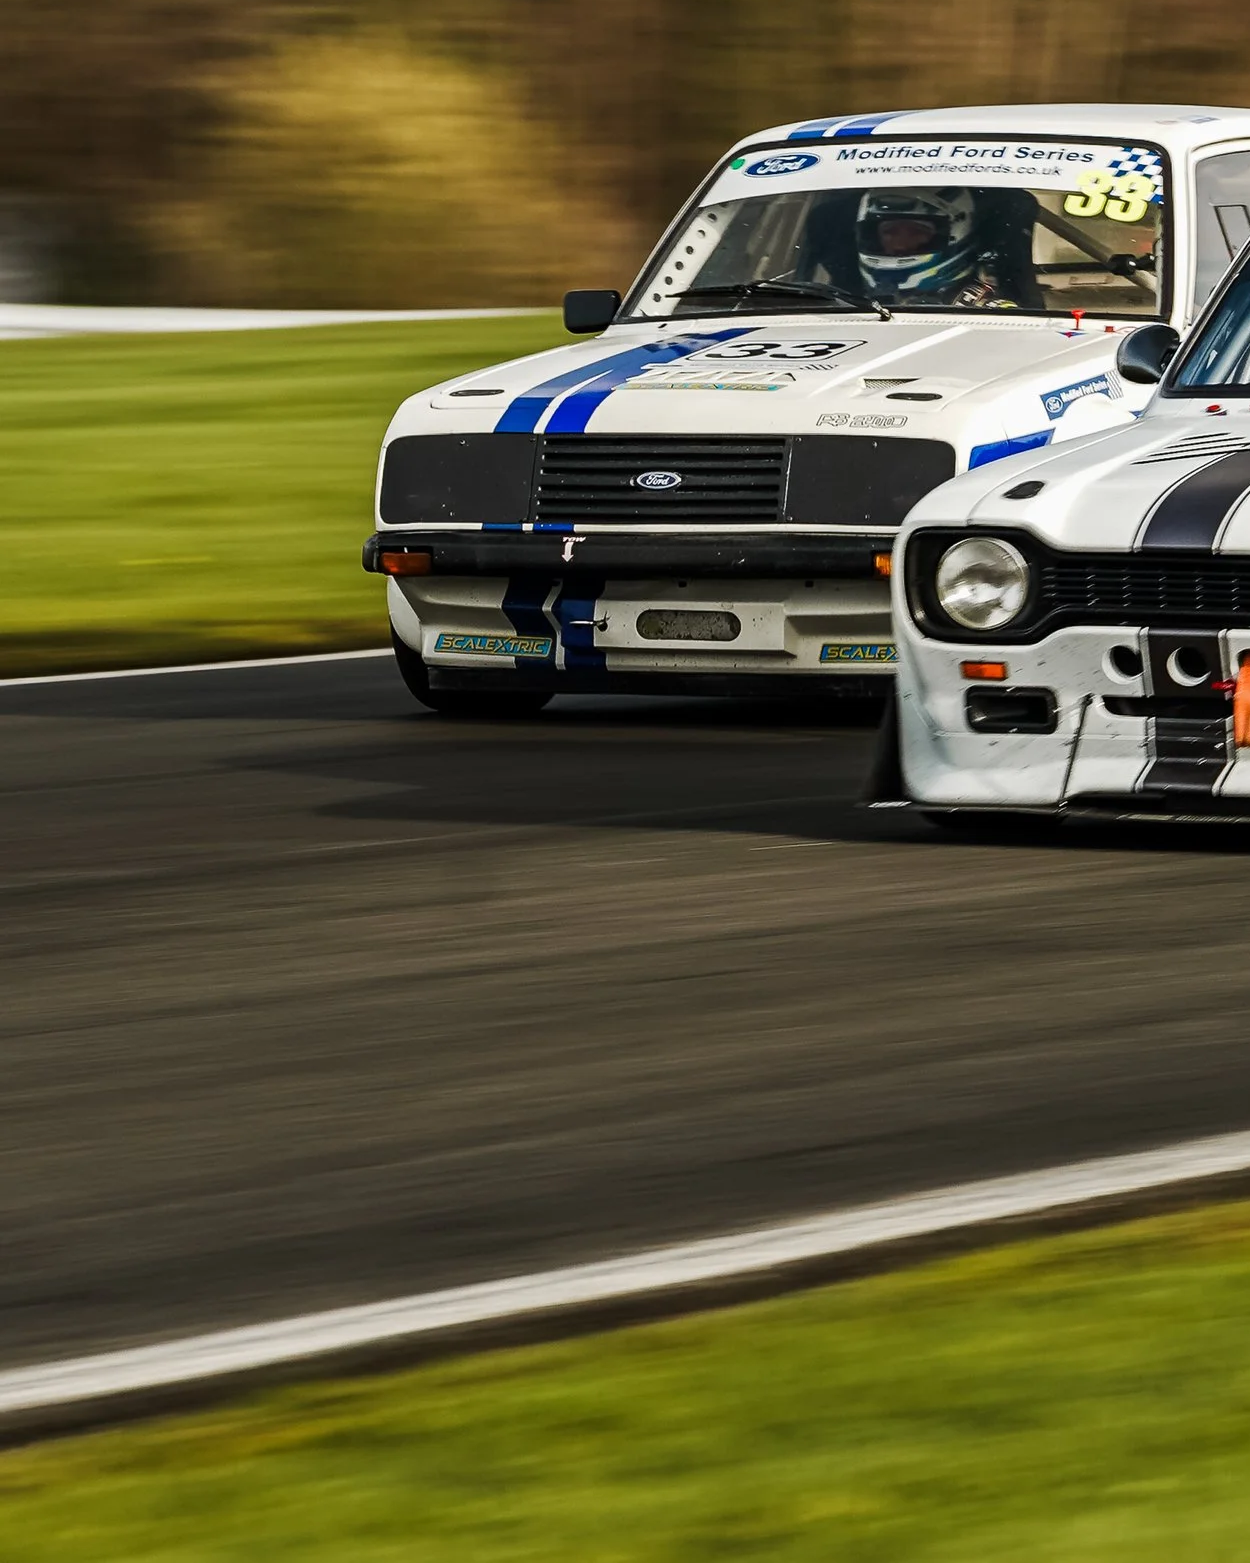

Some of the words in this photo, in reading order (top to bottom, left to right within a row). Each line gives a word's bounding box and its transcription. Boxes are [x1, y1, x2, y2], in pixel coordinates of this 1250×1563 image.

[836, 146, 942, 161] Modified
[950, 145, 1006, 158] Ford
[1014, 146, 1095, 163] Series
[756, 155, 808, 174] Ford
[855, 163, 1063, 176] www.modifiedfords.co.uk
[1063, 170, 1158, 222] 33
[705, 342, 847, 359] 33
[441, 636, 545, 653] SCALEXTRIC
